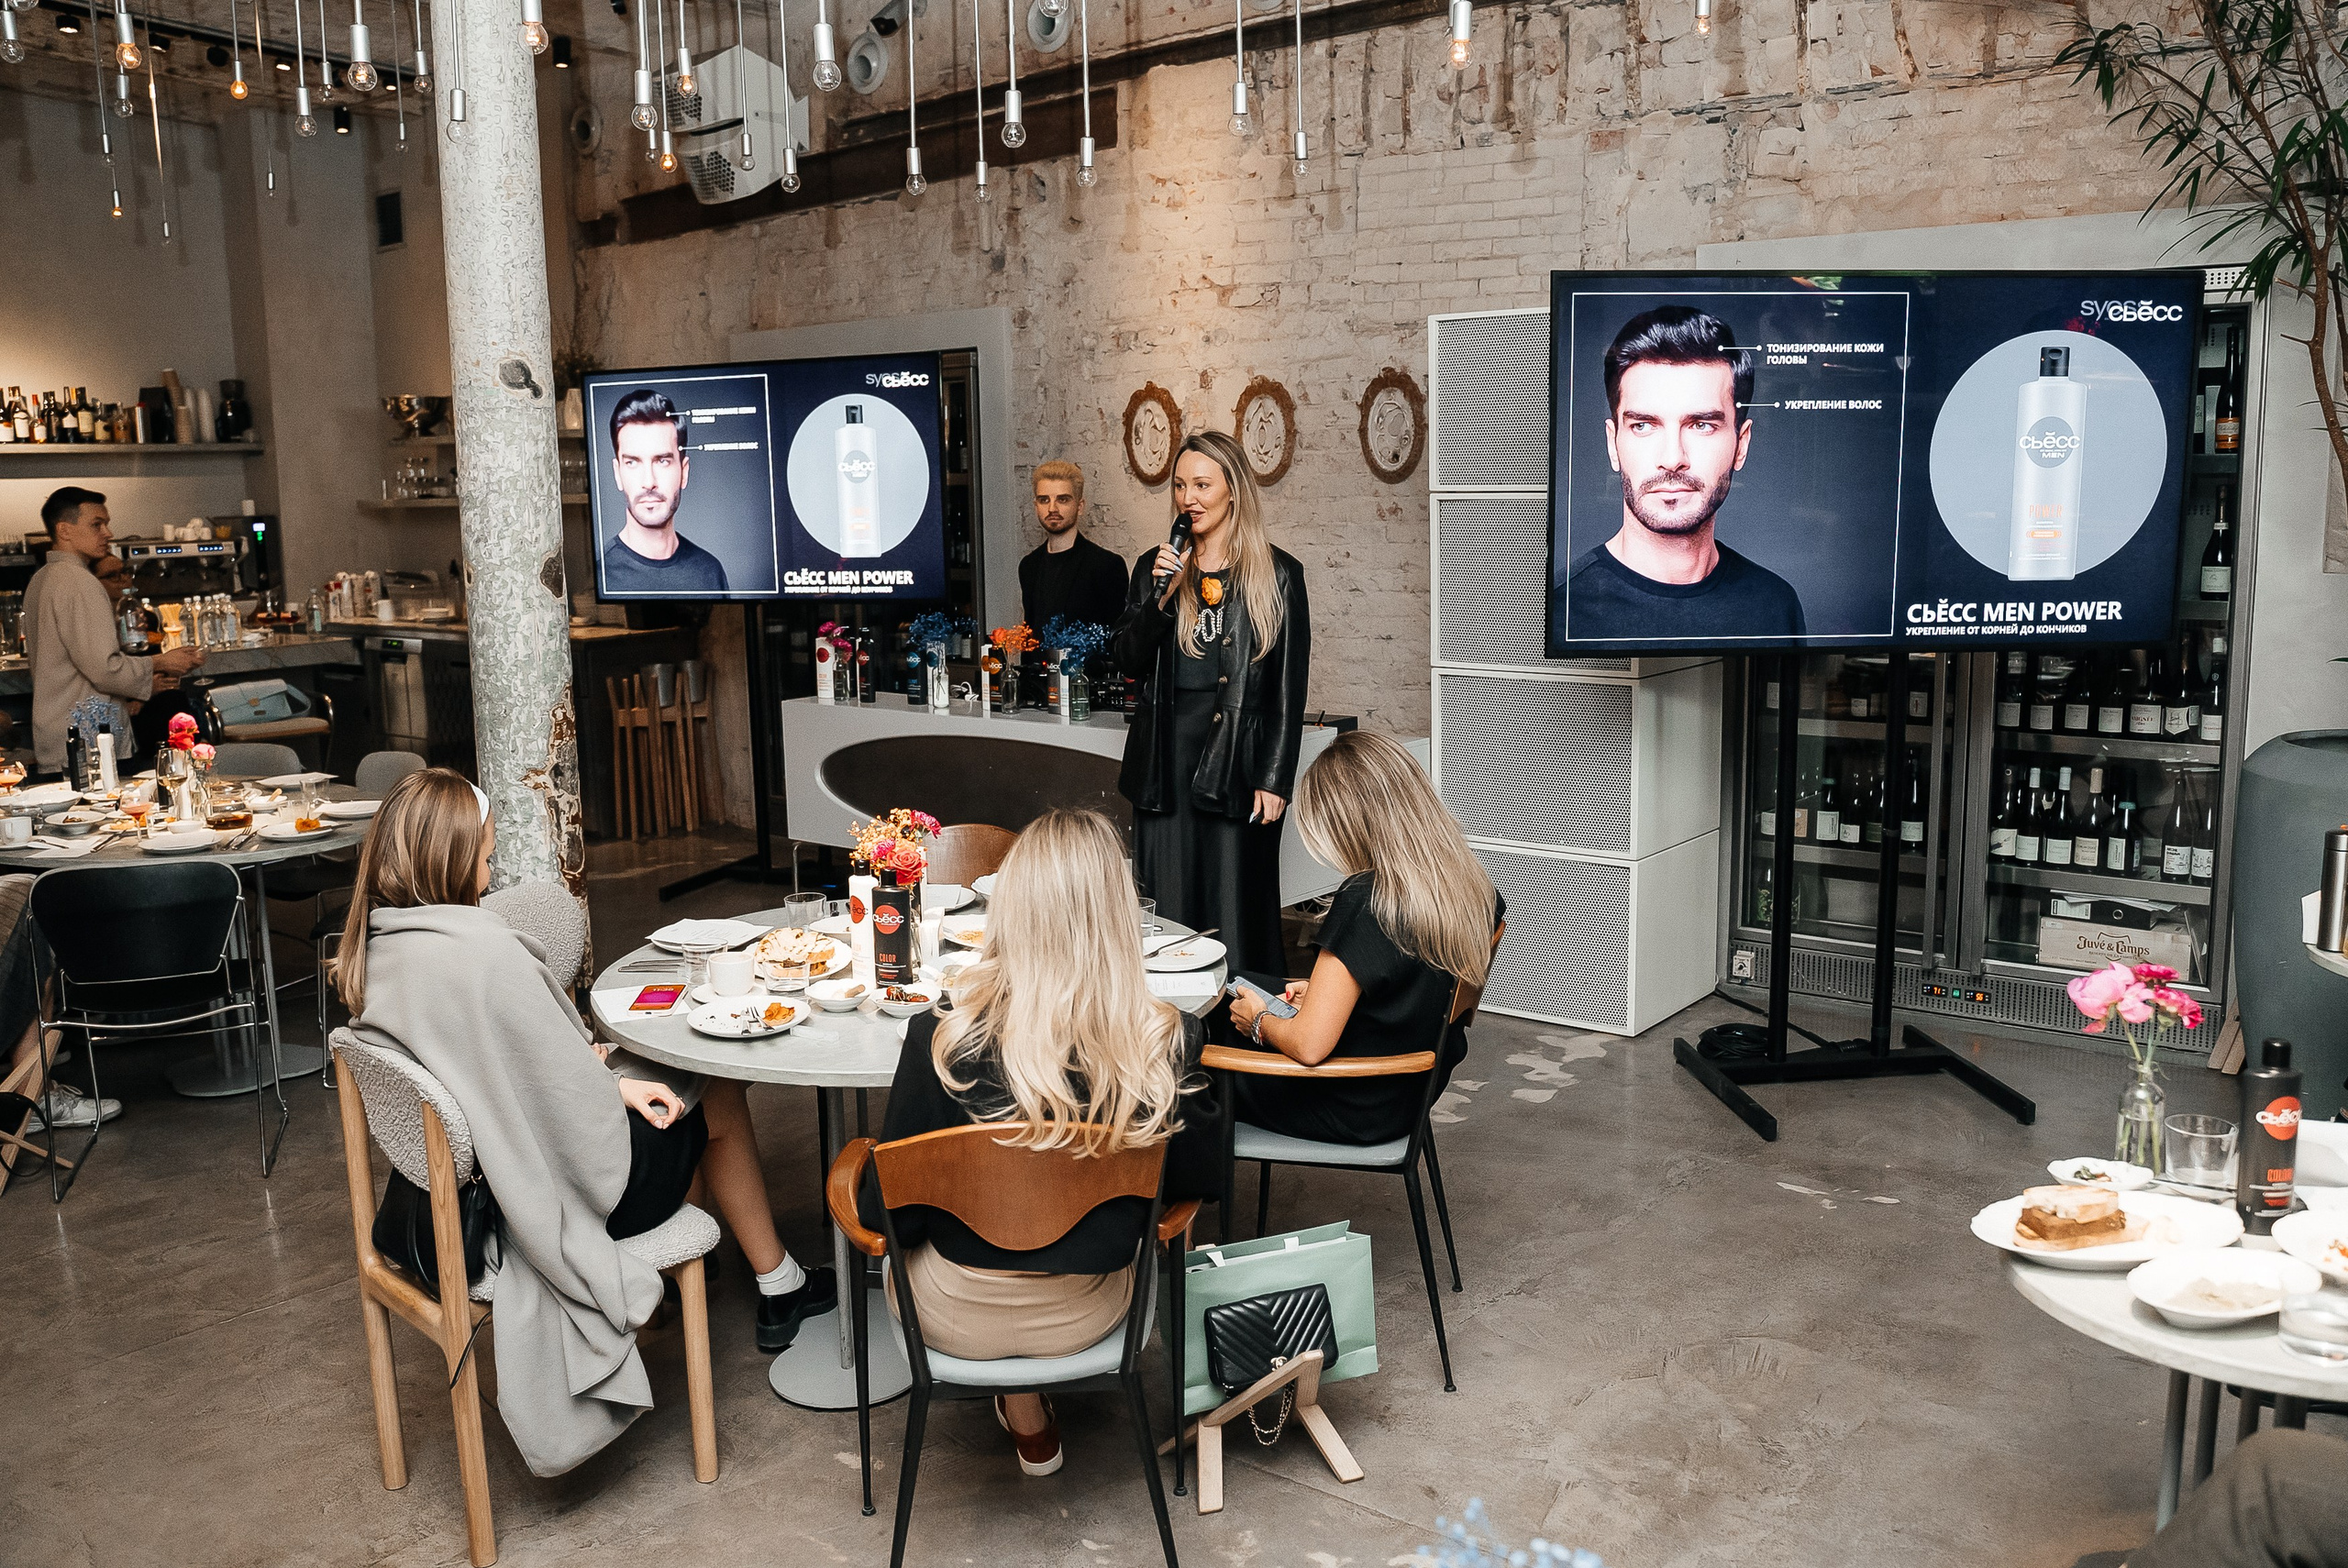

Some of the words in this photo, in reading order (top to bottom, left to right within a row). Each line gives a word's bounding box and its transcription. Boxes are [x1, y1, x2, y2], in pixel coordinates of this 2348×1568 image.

[1767, 343, 1853, 353] ТОНИЗИРОВАНИЕ
[1854, 343, 1885, 353] КОЖИ
[1767, 355, 1808, 365] ГОЛОВЫ
[1784, 400, 1847, 410] УКРЕПЛЕНИЕ
[1848, 400, 1882, 410] ВОЛОС
[2029, 503, 2063, 518] POWER
[828, 570, 859, 585] MEN
[863, 570, 914, 585] POWER
[1983, 602, 2035, 623] MEN
[2042, 601, 2122, 622] POWER
[1906, 626, 1966, 636] УКРЕПЛЕНИЕ
[1966, 625, 1980, 635] ОТ
[1981, 624, 2018, 635] КОРНЕЙ
[2019, 624, 2034, 635] ДО
[2035, 624, 2088, 635] КОНЧИКОВ
[2077, 935, 2106, 950] Juvé
[2106, 944, 2115, 952] &
[2116, 940, 2150, 957] Camps
